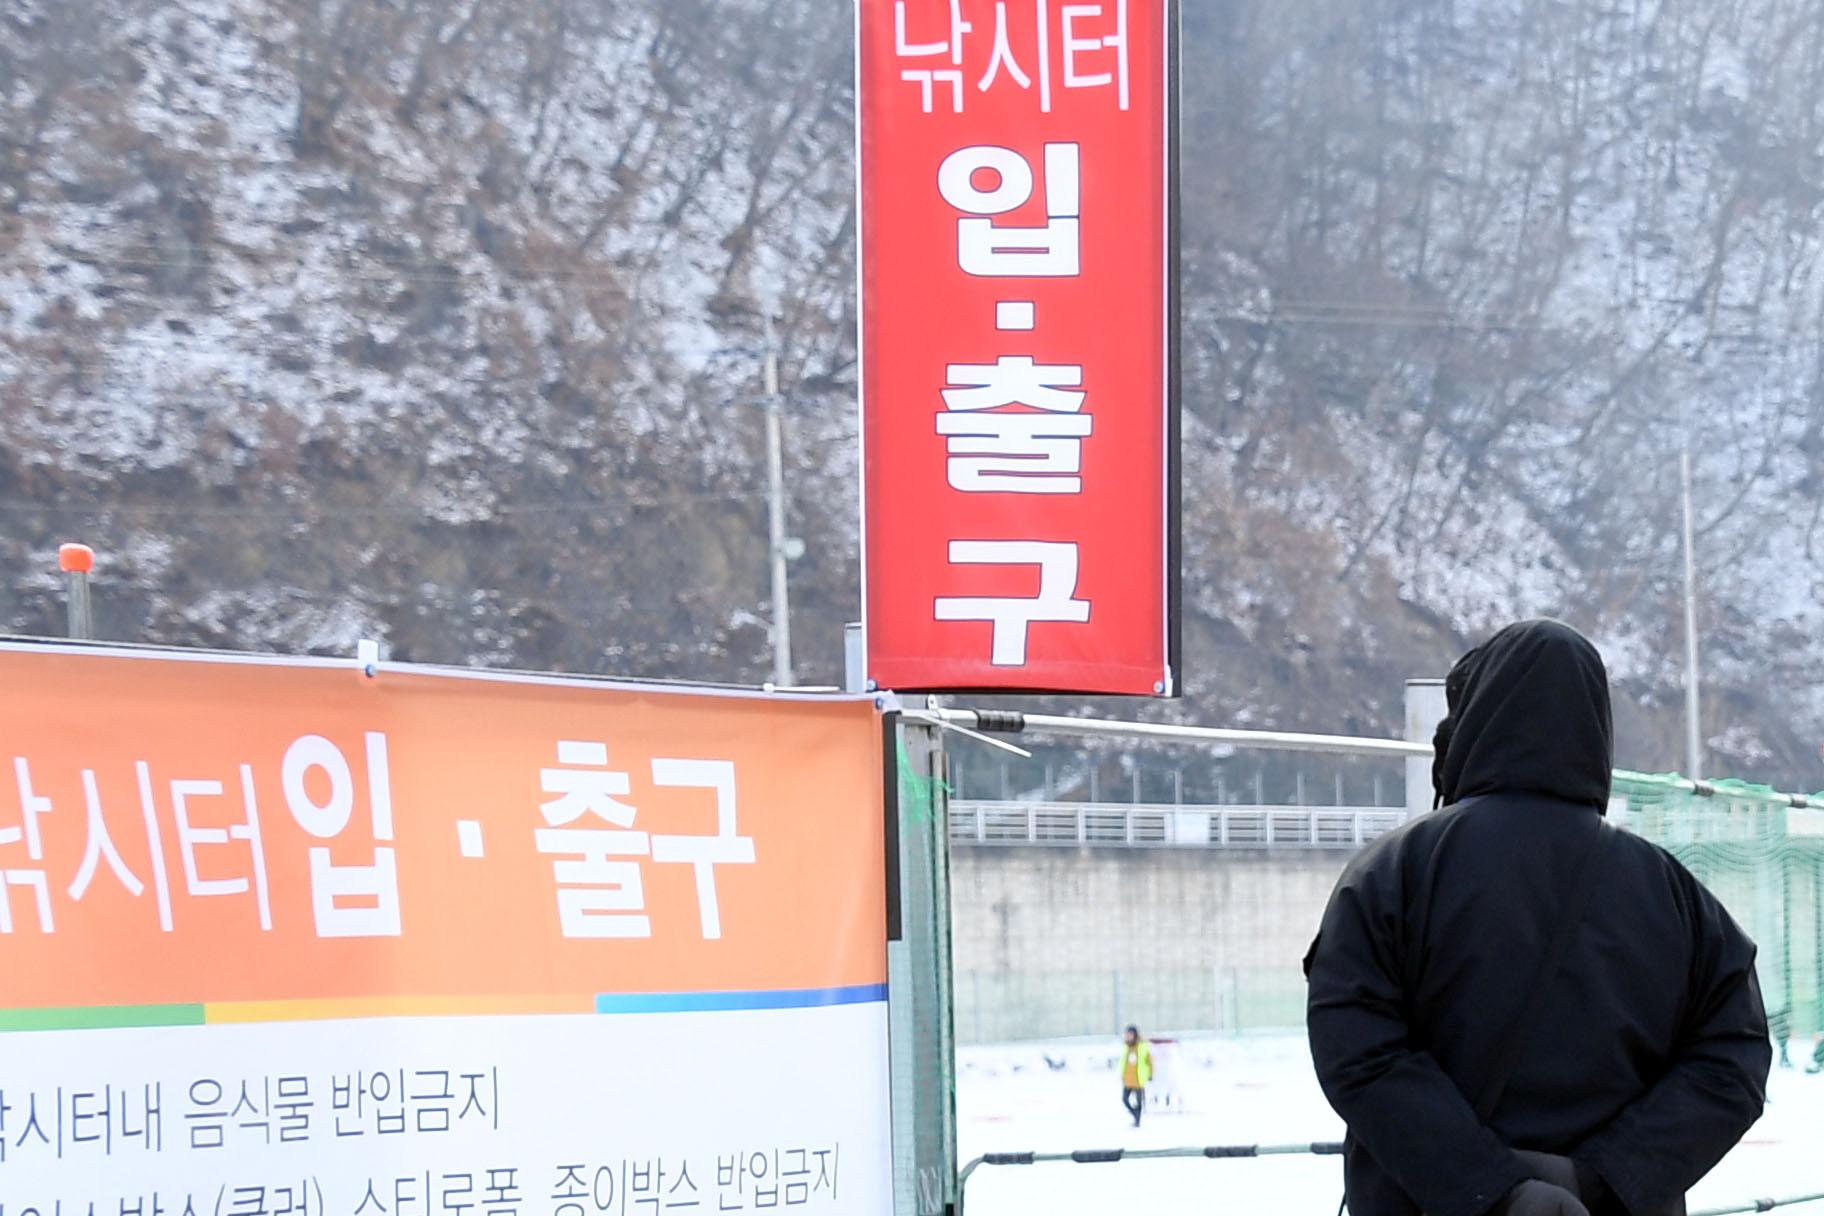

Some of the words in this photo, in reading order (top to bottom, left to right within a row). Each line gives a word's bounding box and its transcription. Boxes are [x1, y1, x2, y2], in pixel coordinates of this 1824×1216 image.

[896, 0, 1129, 112] 낚시터
[184, 1076, 315, 1151] 음식물
[332, 1066, 499, 1139] 반입금지
[716, 1142, 840, 1211] 반입금지
